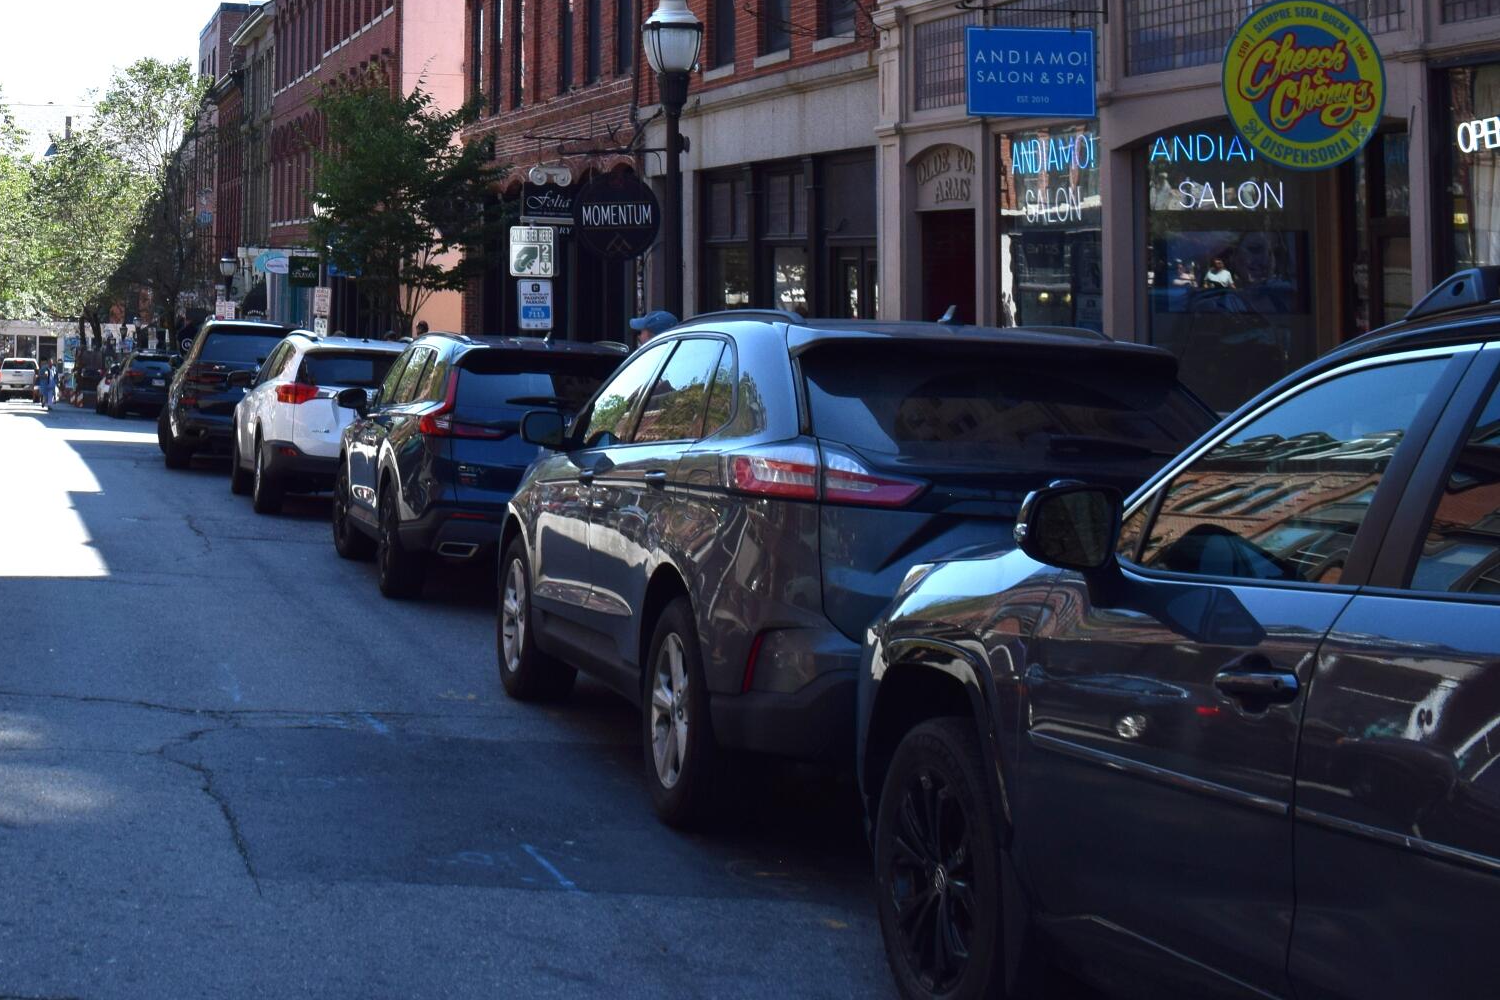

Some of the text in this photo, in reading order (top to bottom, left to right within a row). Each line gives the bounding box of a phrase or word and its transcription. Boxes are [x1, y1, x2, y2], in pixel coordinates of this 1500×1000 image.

[1253, 8, 1292, 34] SIEMPRE
[975, 50, 1088, 66] ANDIAMO!
[1238, 32, 1348, 100] Cheech
[977, 70, 1086, 85] SALON & SPA
[1313, 69, 1329, 85] &
[1457, 116, 1500, 153] OPE
[1011, 134, 1095, 175] ANDIAMO!
[1150, 133, 1256, 163] ANDIA
[1260, 135, 1352, 165] DISPENSORIA
[526, 190, 572, 210] Folia
[935, 177, 971, 203] ARMS
[1178, 180, 1284, 210] SALON
[582, 203, 653, 227] MOMENTUM
[1025, 187, 1083, 224] SALON
[521, 229, 538, 242] METER
[538, 229, 552, 242] HERE
[542, 245, 550, 257] 2
